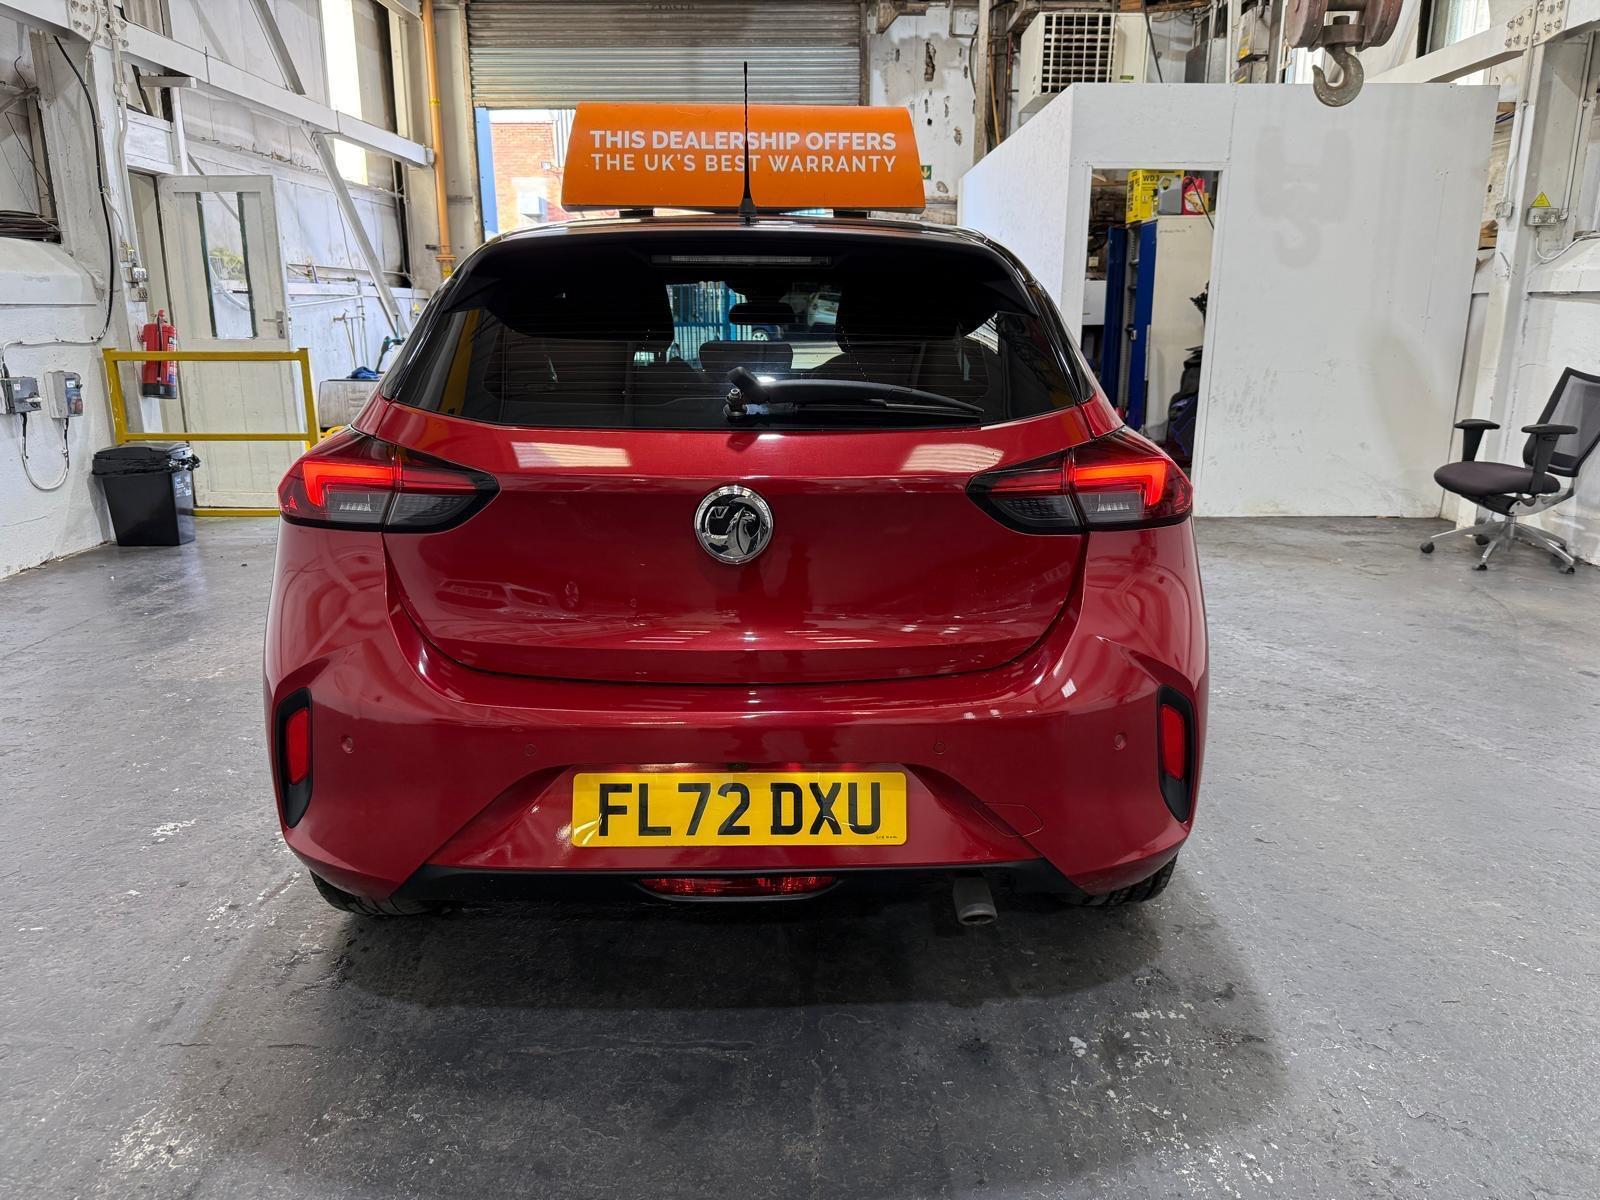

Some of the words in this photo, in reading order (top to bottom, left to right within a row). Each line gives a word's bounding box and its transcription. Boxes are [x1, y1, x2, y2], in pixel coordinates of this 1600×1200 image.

[589, 130, 646, 149] THIS
[652, 130, 801, 150] DEALERSHIP
[805, 131, 897, 151] OFFERS
[590, 153, 636, 171] THE
[643, 153, 697, 172] UK'S
[705, 154, 761, 172] BEST
[767, 155, 897, 173] WARRANTY
[598, 782, 751, 837] FL72
[770, 781, 882, 836] DXU
